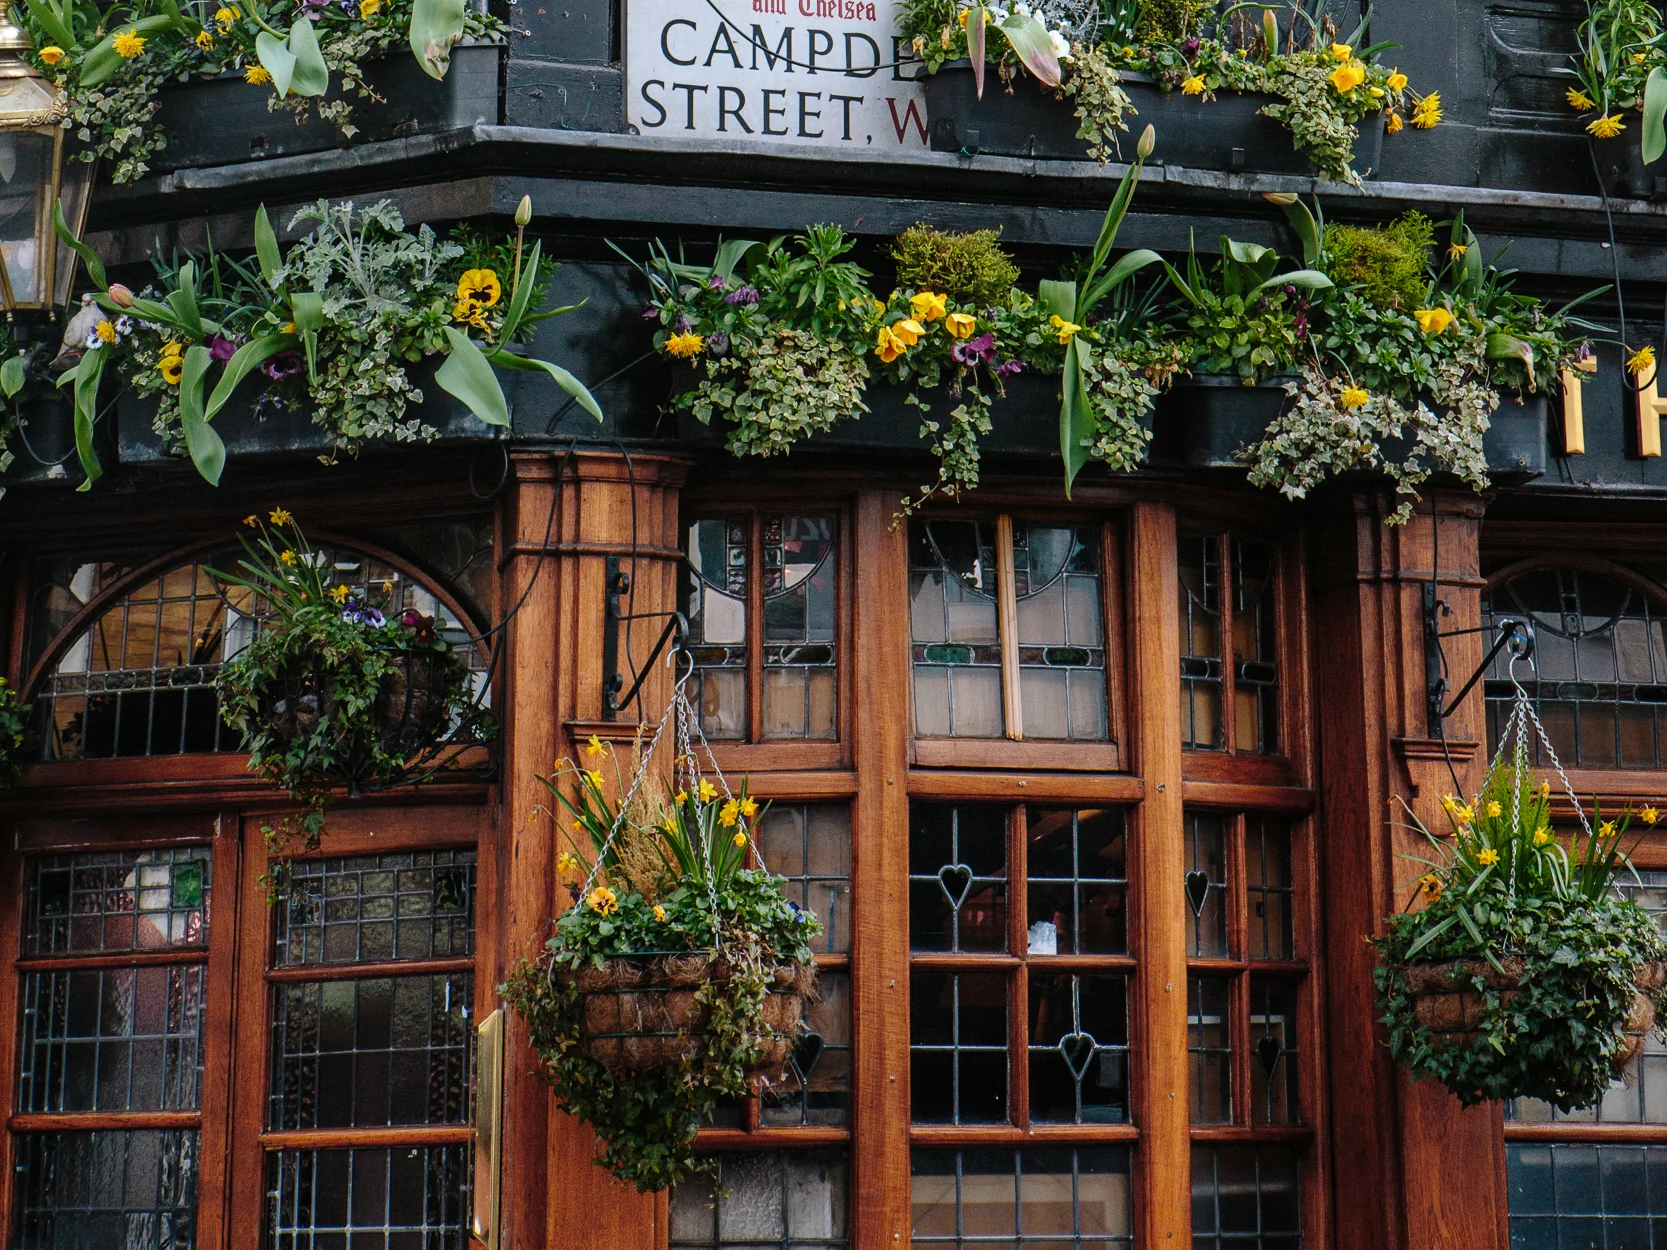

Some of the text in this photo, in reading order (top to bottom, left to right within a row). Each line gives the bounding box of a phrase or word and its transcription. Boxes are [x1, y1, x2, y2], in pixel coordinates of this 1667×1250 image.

[660, 18, 923, 82] CAMPDE
[640, 79, 930, 145] STREET, W
